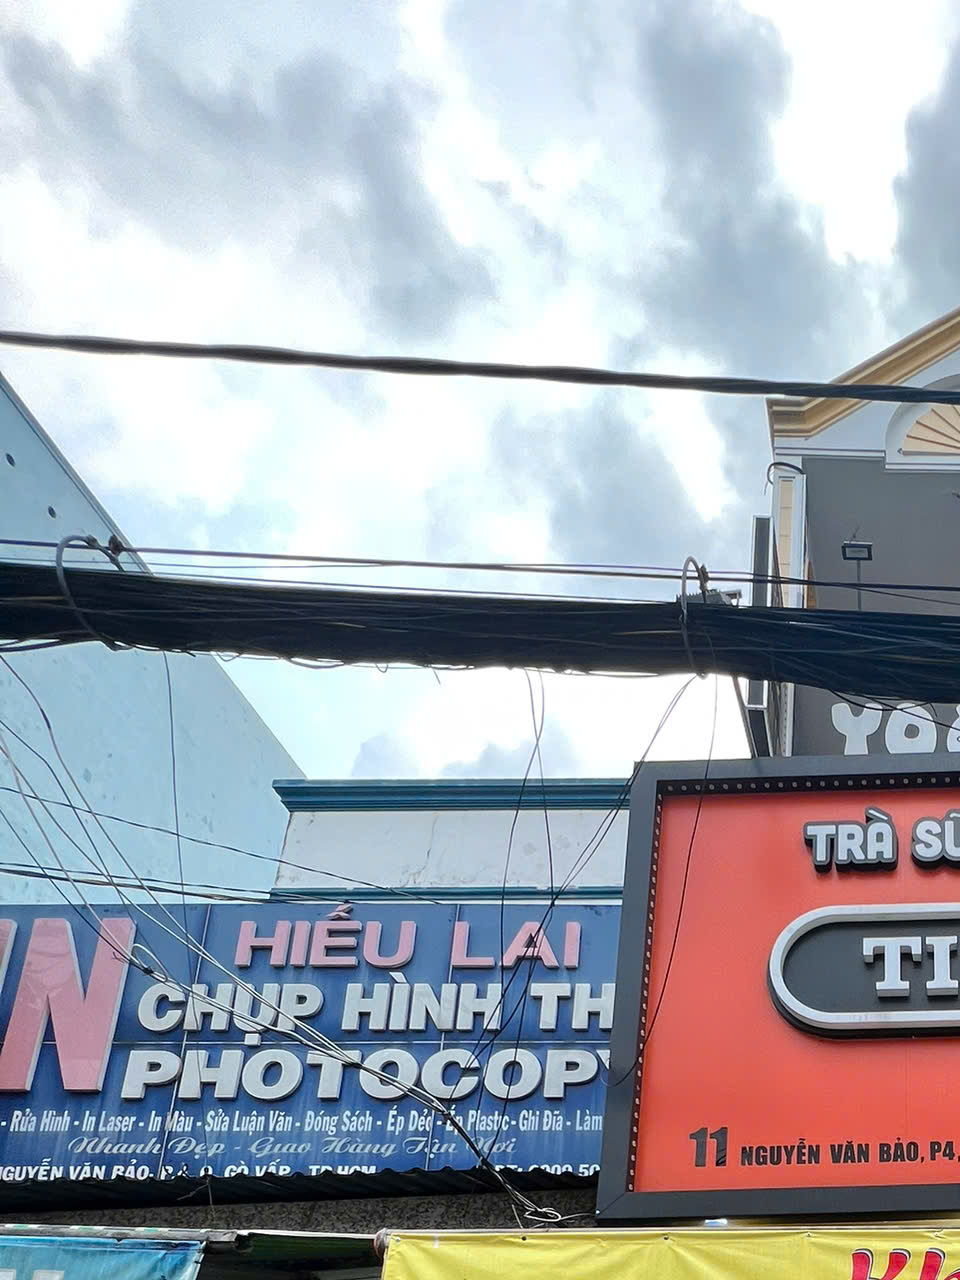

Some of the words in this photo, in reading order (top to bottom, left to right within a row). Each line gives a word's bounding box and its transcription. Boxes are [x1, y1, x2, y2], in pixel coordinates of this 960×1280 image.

[804, 807, 898, 872] TRÀ
[234, 902, 417, 968] HIẾU
[450, 920, 582, 969] LAI
[138, 982, 325, 1046] CHỤP
[340, 971, 505, 1033] HÌNH
[9, 1108, 36, 1132] Rửa
[40, 1109, 71, 1132] Hình
[82, 1111, 96, 1132] In
[99, 1111, 137, 1132] Laser
[148, 1111, 161, 1132] In
[165, 1109, 194, 1132] Màu
[205, 1108, 230, 1132] Sửa
[233, 1111, 266, 1136] Luận
[269, 1110, 293, 1132] Văn
[304, 1109, 338, 1135] Đóng
[342, 1108, 373, 1132] Sách
[386, 1105, 404, 1136] Ép
[519, 1109, 540, 1132] Ghi
[542, 1109, 564, 1132] Đĩa
[576, 1108, 604, 1132] Làm
[688, 1125, 729, 1168] 11
[740, 1136, 821, 1167] NGUYỄN
[829, 1138, 871, 1166] VĂN
[878, 1135, 925, 1166] BẢO,
[68, 1162, 106, 1181] VĂN
